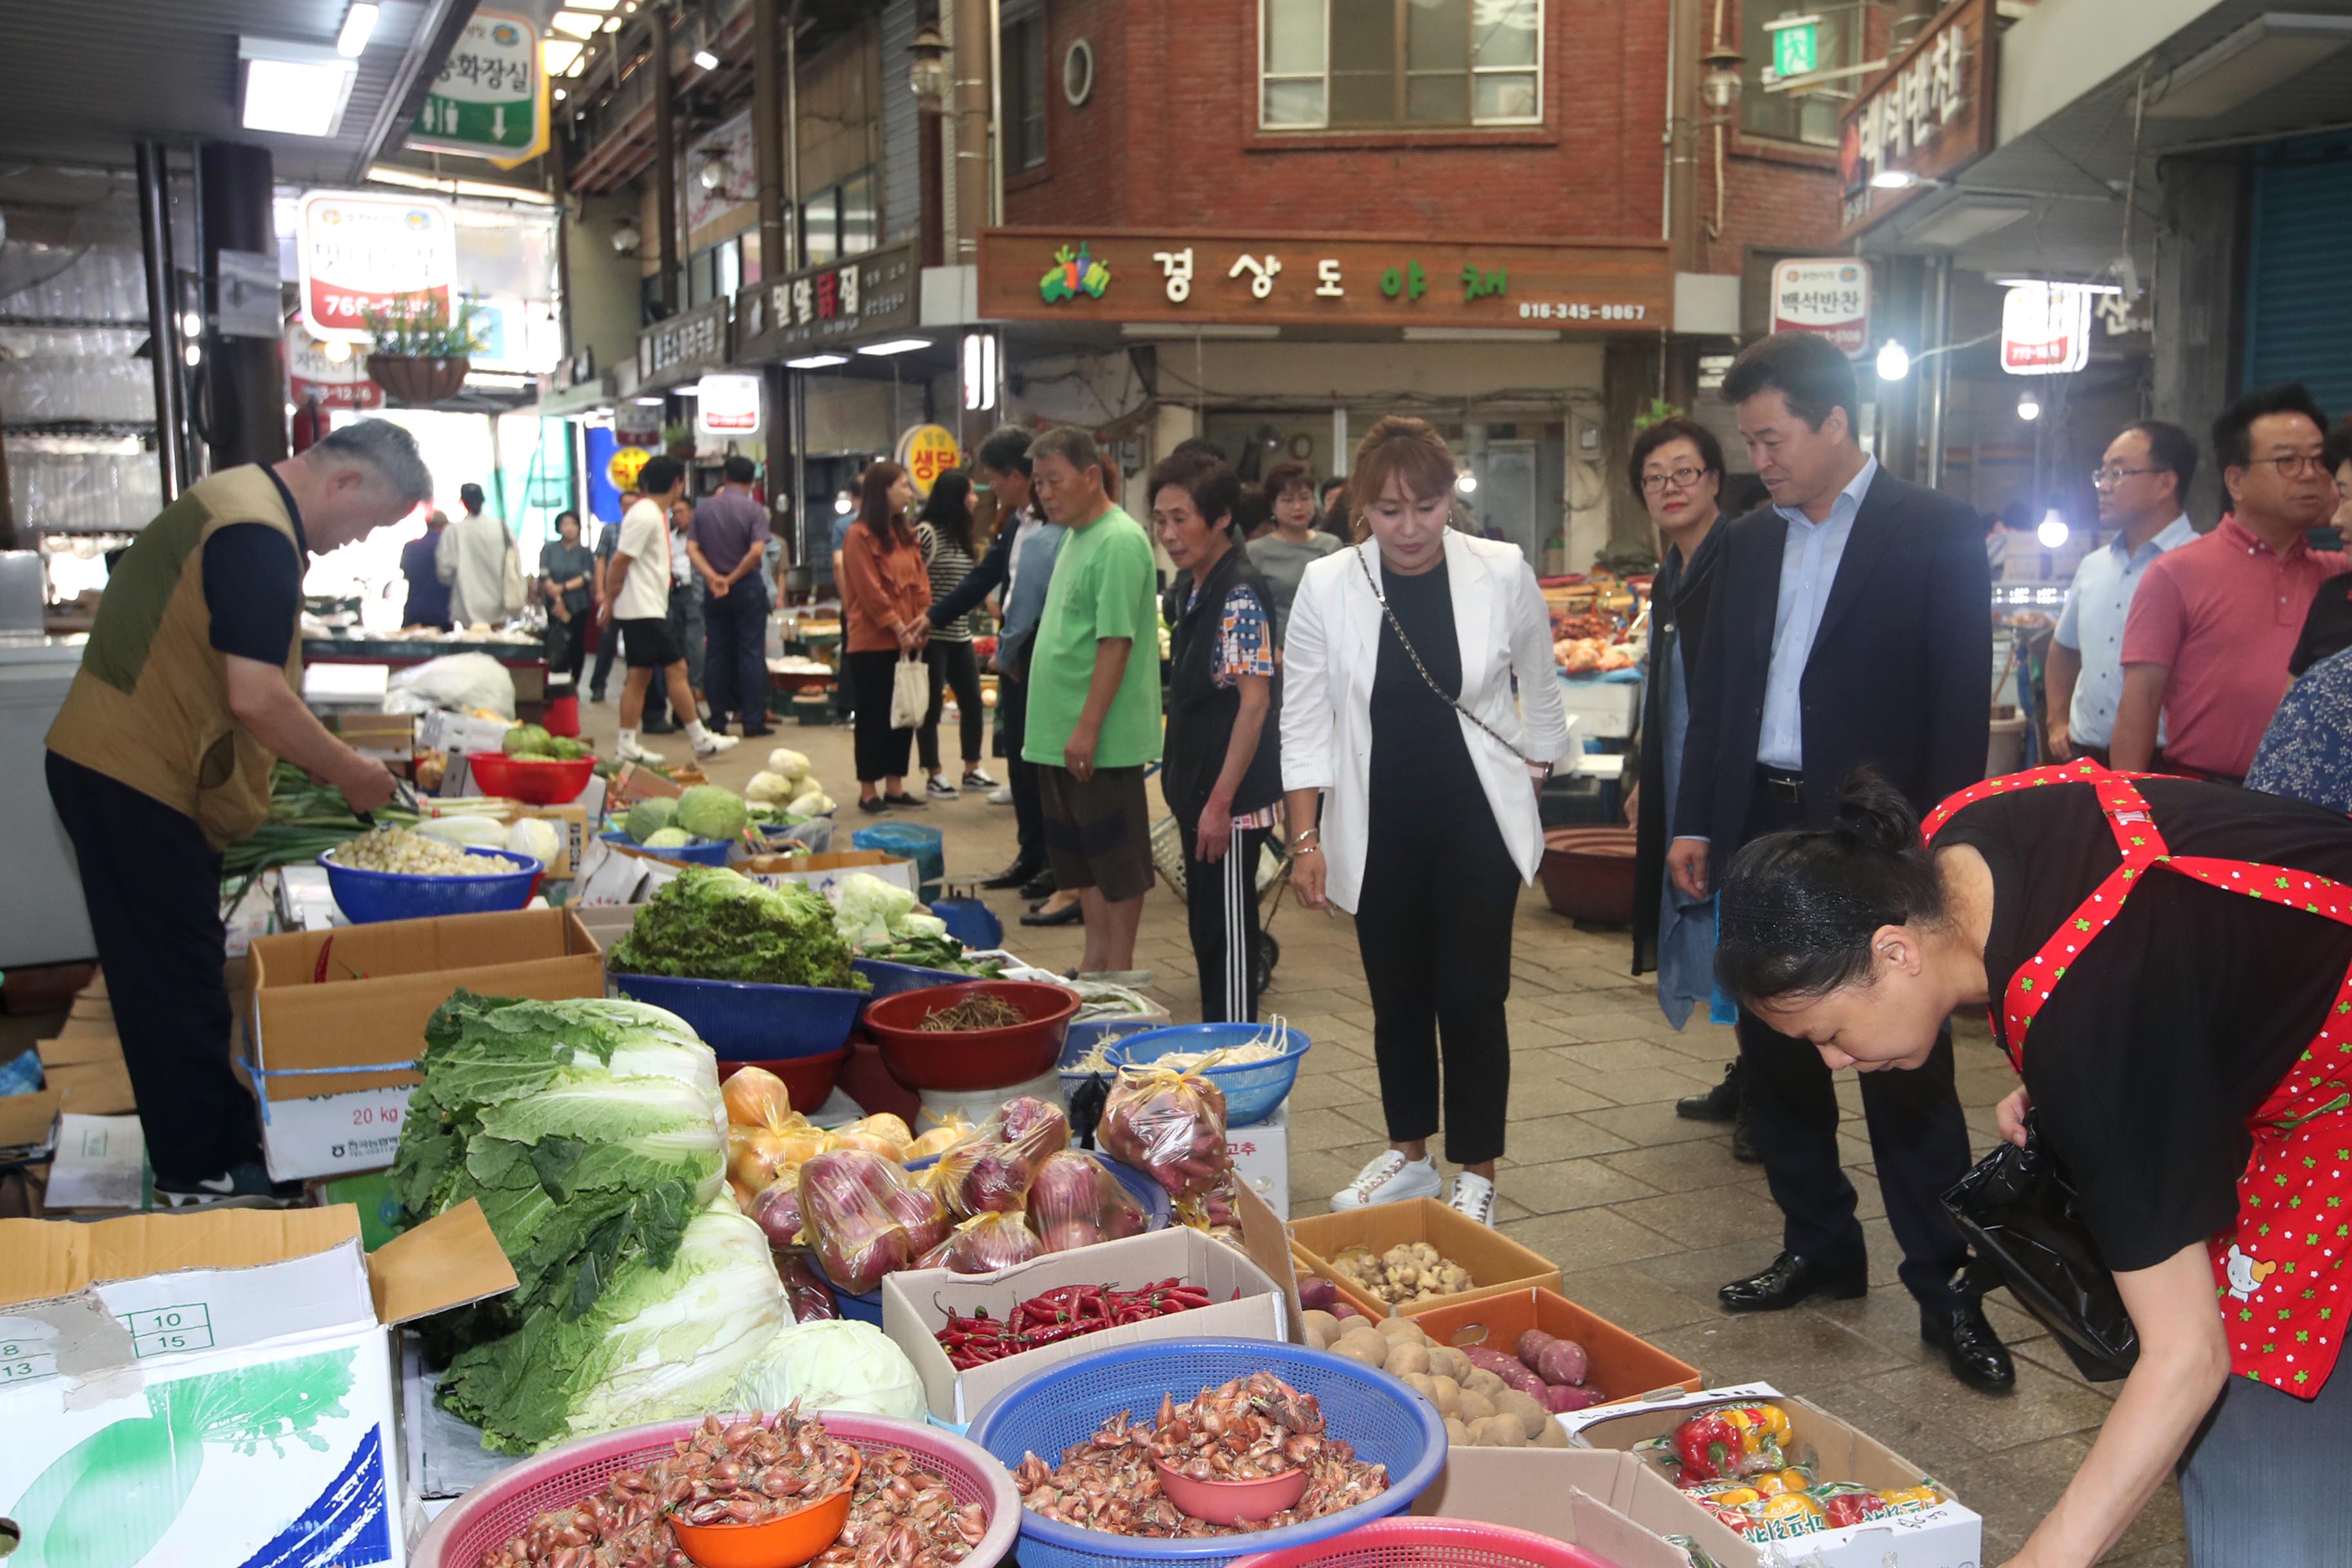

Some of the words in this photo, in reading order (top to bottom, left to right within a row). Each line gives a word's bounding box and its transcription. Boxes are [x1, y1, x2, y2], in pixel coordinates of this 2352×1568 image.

[1153, 248, 1344, 302] 경상도
[1380, 260, 1507, 300] 야채
[1781, 291, 1860, 314] 백석반찬
[353, 1108, 373, 1126] 20
[380, 1106, 398, 1123] kg
[153, 1313, 182, 1328] 10
[159, 1335, 186, 1348] 15
[3, 1362, 33, 1377] 13
